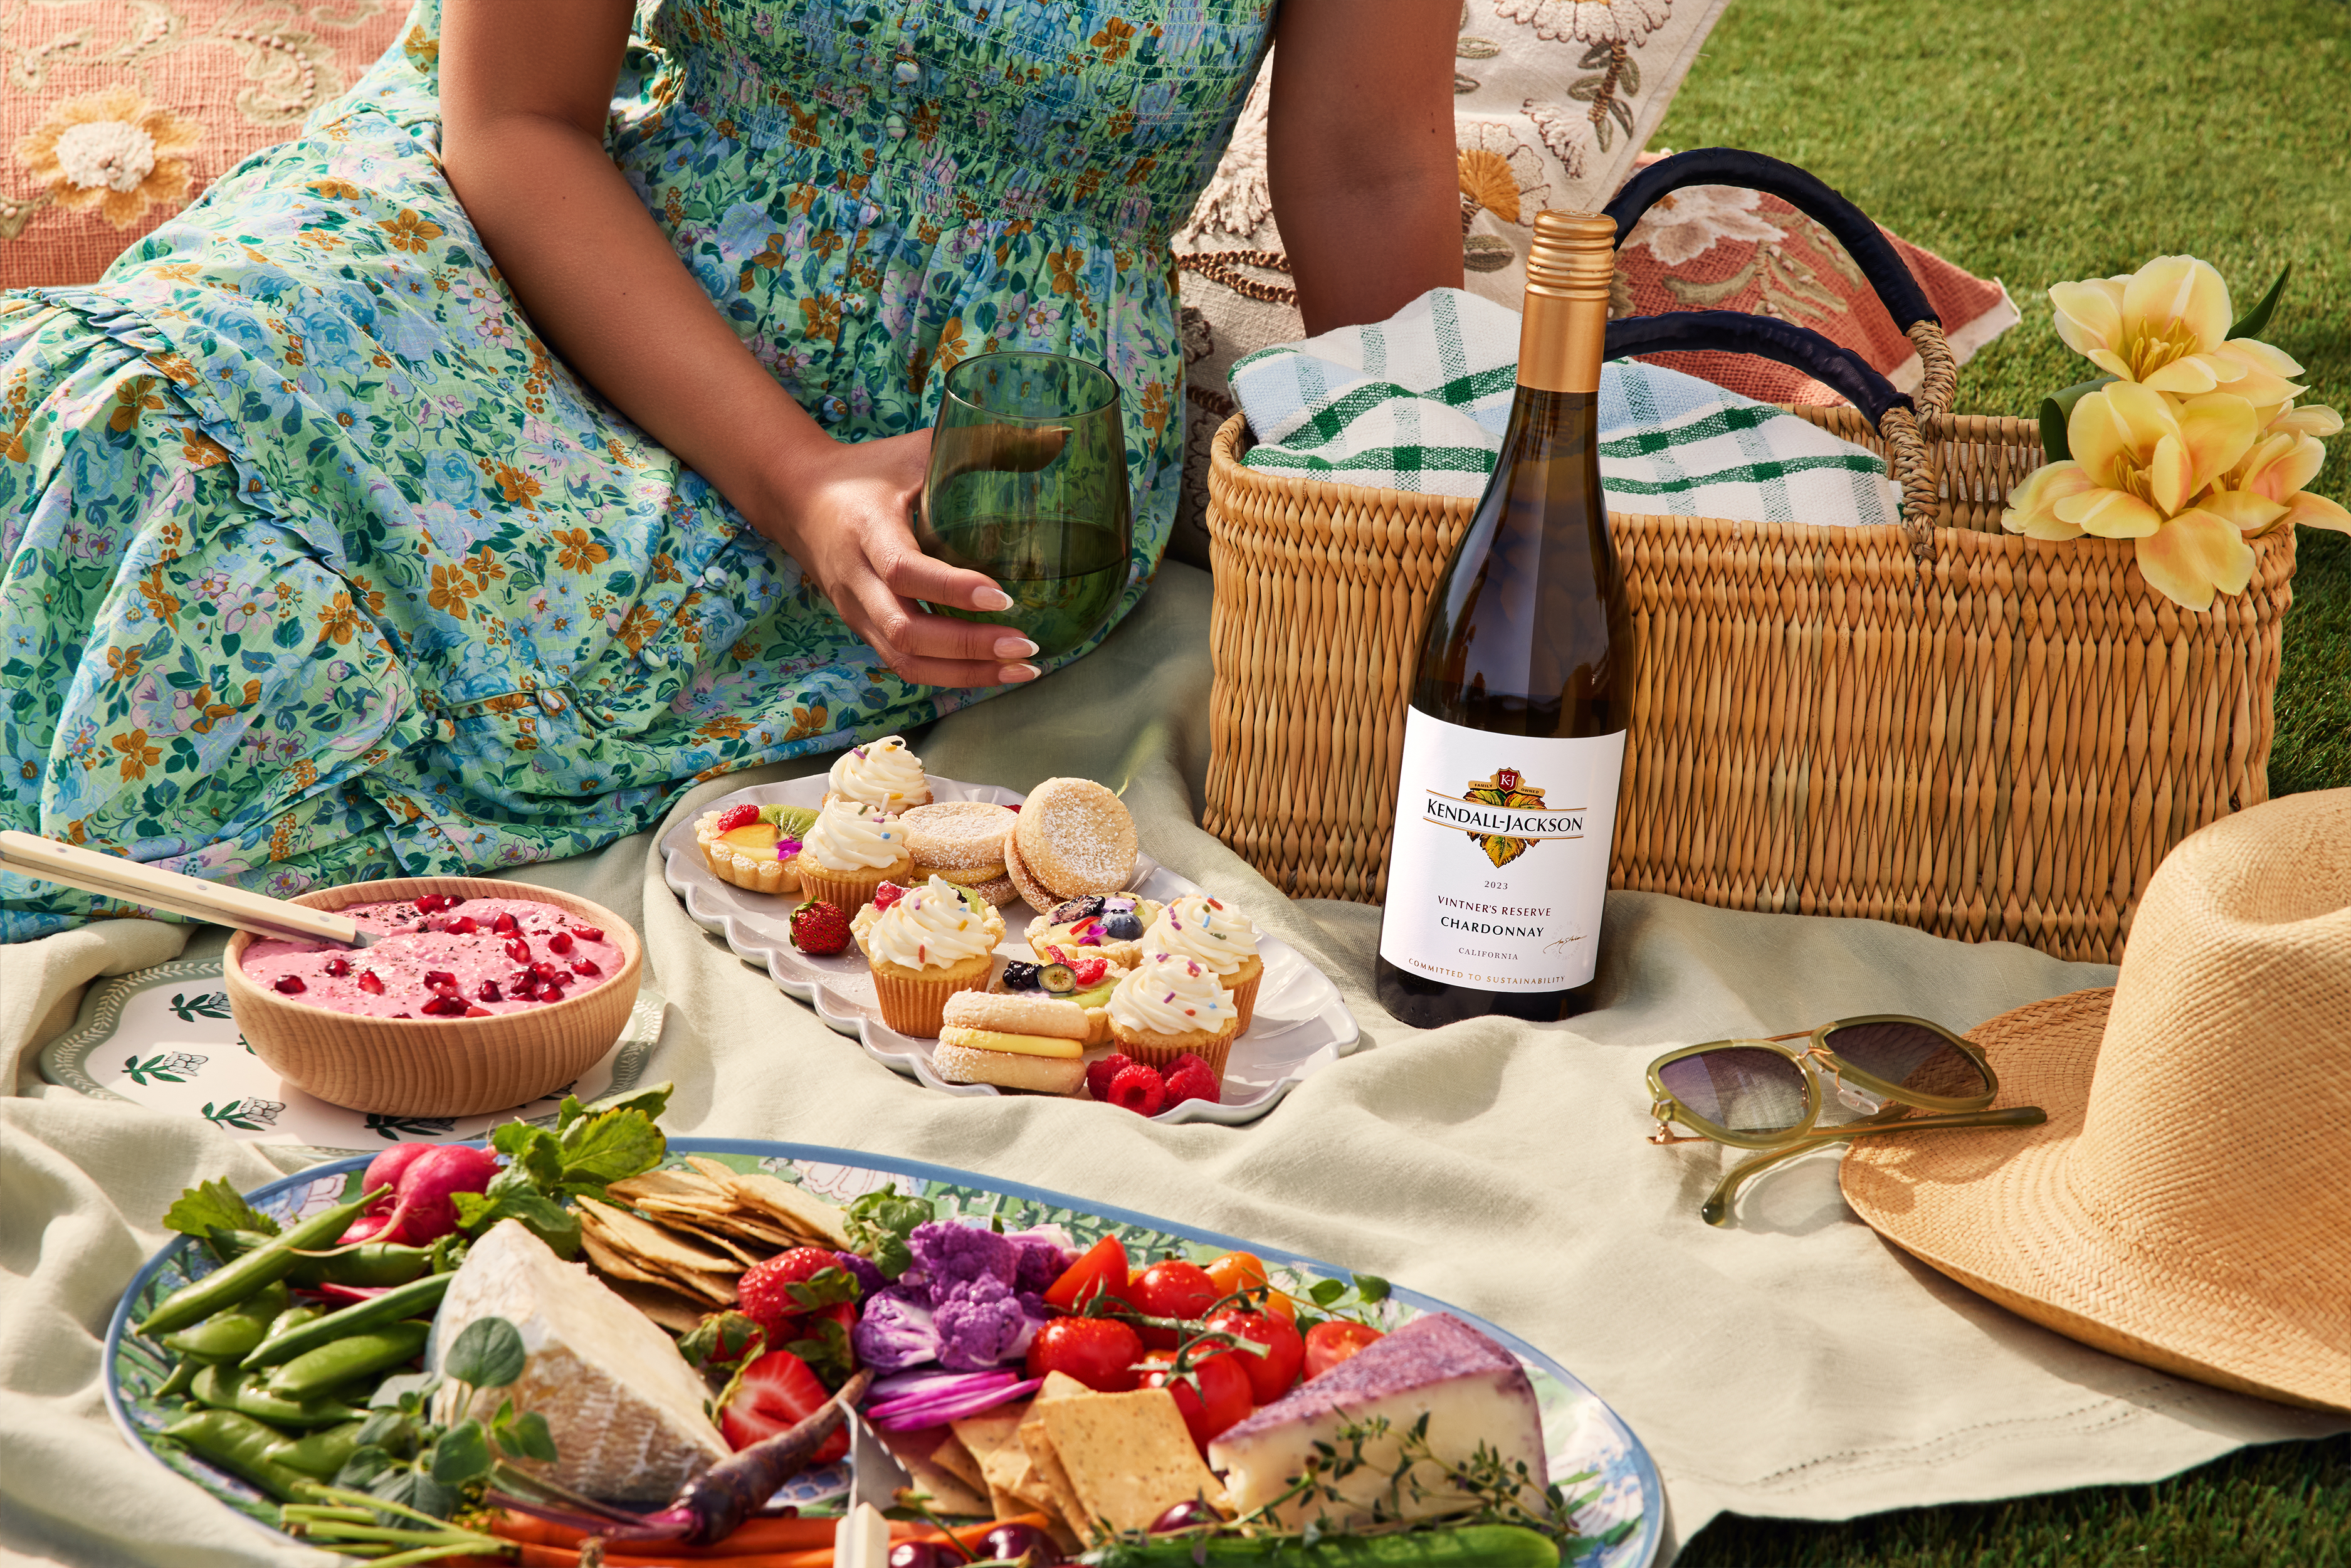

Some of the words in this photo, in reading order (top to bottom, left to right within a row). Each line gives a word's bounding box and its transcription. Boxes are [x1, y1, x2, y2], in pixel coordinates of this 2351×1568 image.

[1428, 798, 1583, 832] KENDALL-JACKSON
[1484, 880, 1508, 890] 2023
[1438, 895, 1497, 914] VINTNER'S
[1502, 907, 1552, 917] RESERVE
[1441, 916, 1544, 937] CHARDONNAY
[1458, 947, 1518, 960] CALIFORNIA
[1409, 958, 1463, 978] COMMITTED
[1468, 973, 1481, 981] TO
[1486, 976, 1565, 984] SUSTAINABILITY
